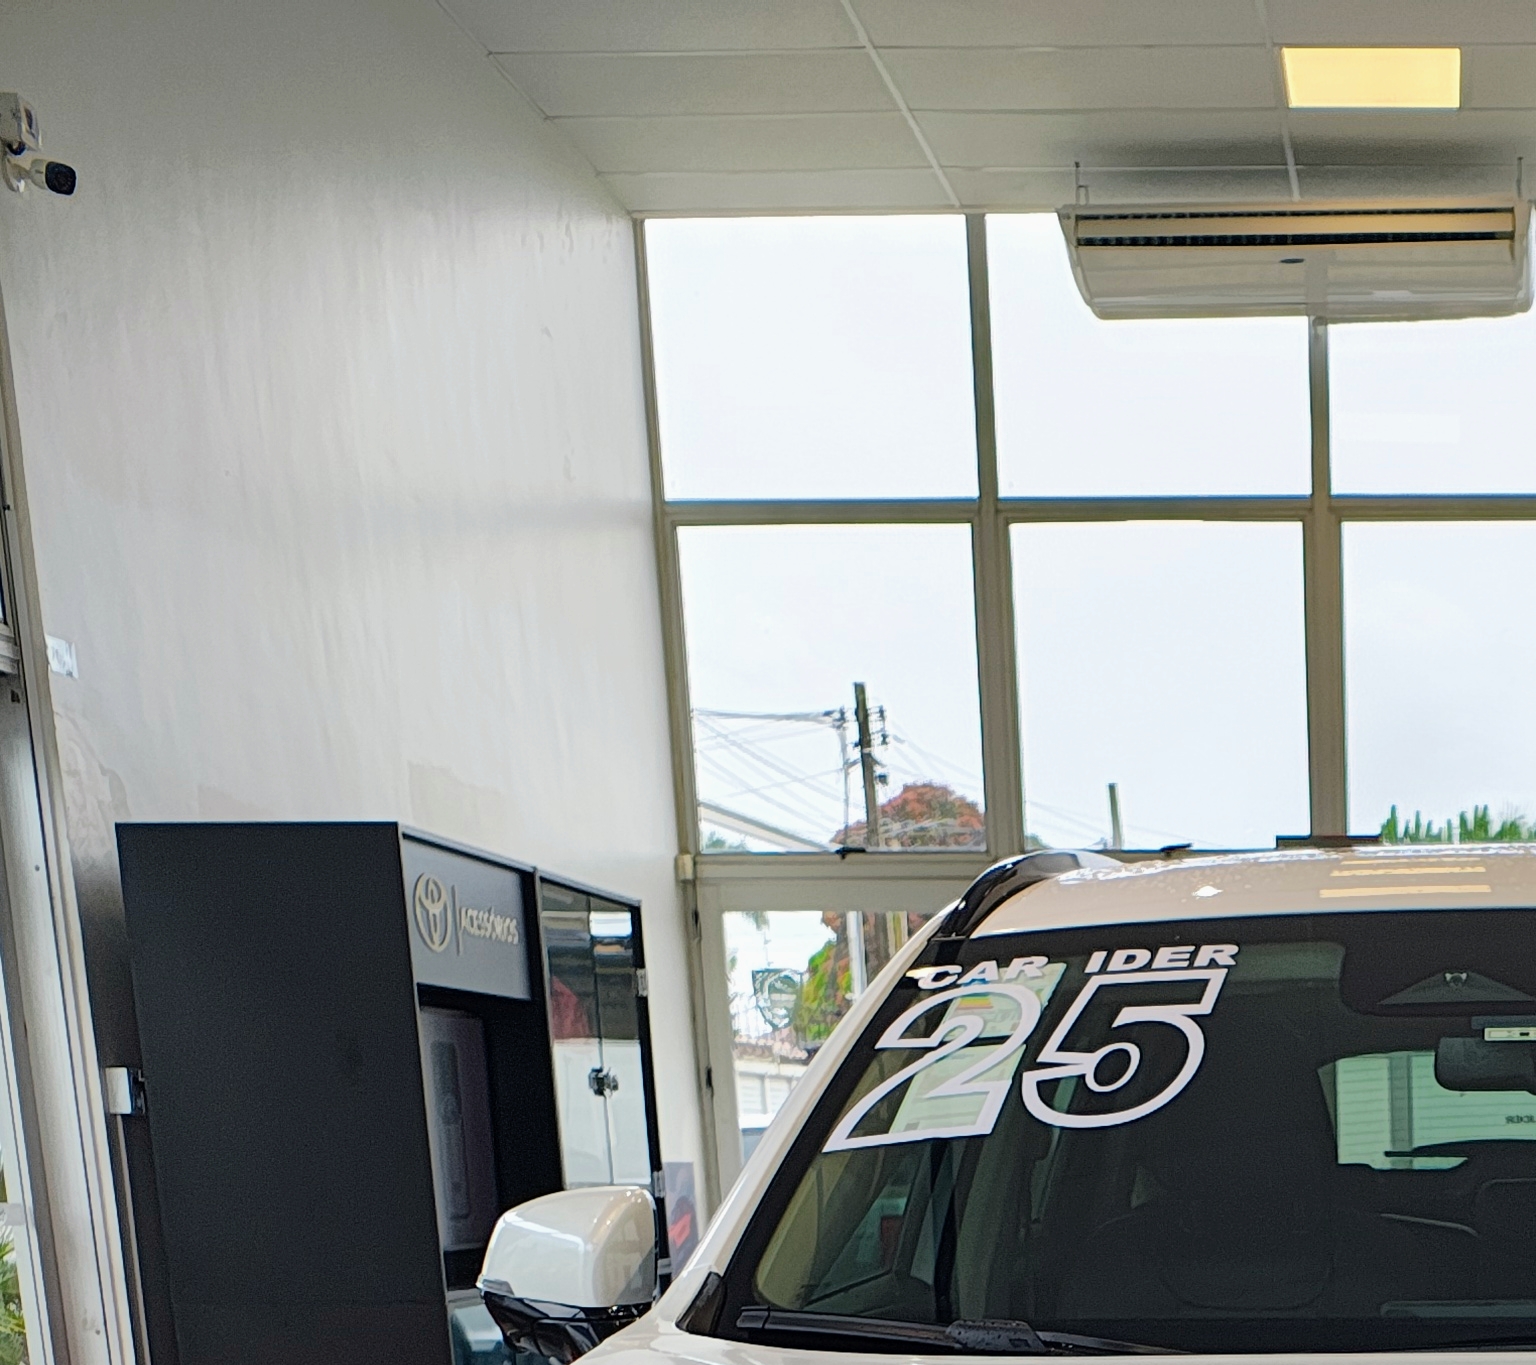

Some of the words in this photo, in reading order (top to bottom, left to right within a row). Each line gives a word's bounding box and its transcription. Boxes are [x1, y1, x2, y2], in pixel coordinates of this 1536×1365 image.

[907, 956, 1050, 990] CAR
[1084, 944, 1239, 974] IDER
[822, 968, 1228, 1155] 25
